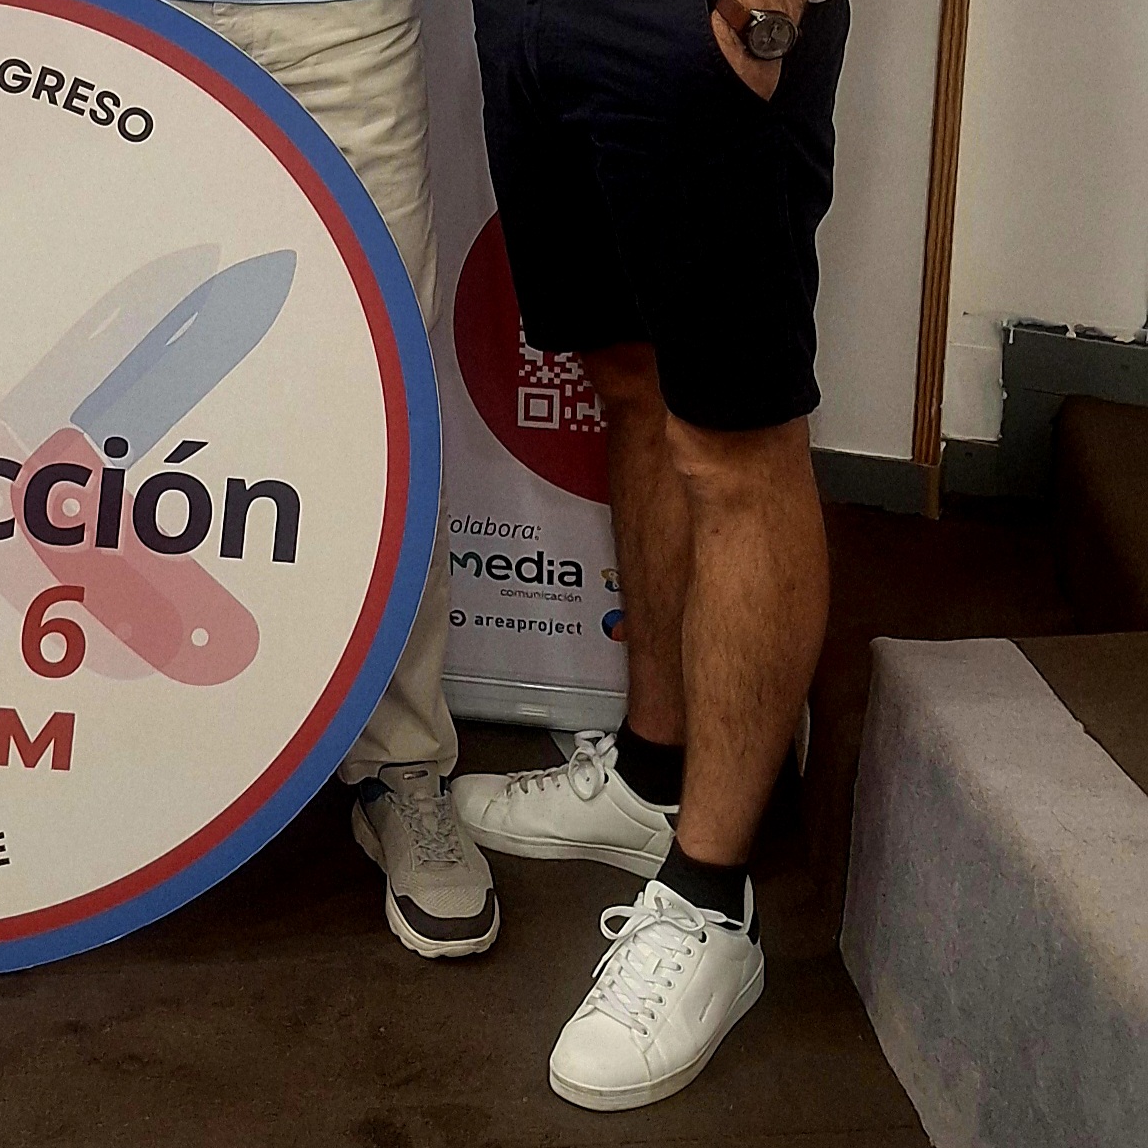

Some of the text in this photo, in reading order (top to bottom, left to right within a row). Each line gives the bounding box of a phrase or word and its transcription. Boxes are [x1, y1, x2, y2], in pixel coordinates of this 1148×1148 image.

[449, 514, 542, 540] olabora:
[500, 588, 582, 603] comunicación
[474, 613, 583, 636] areaproject
